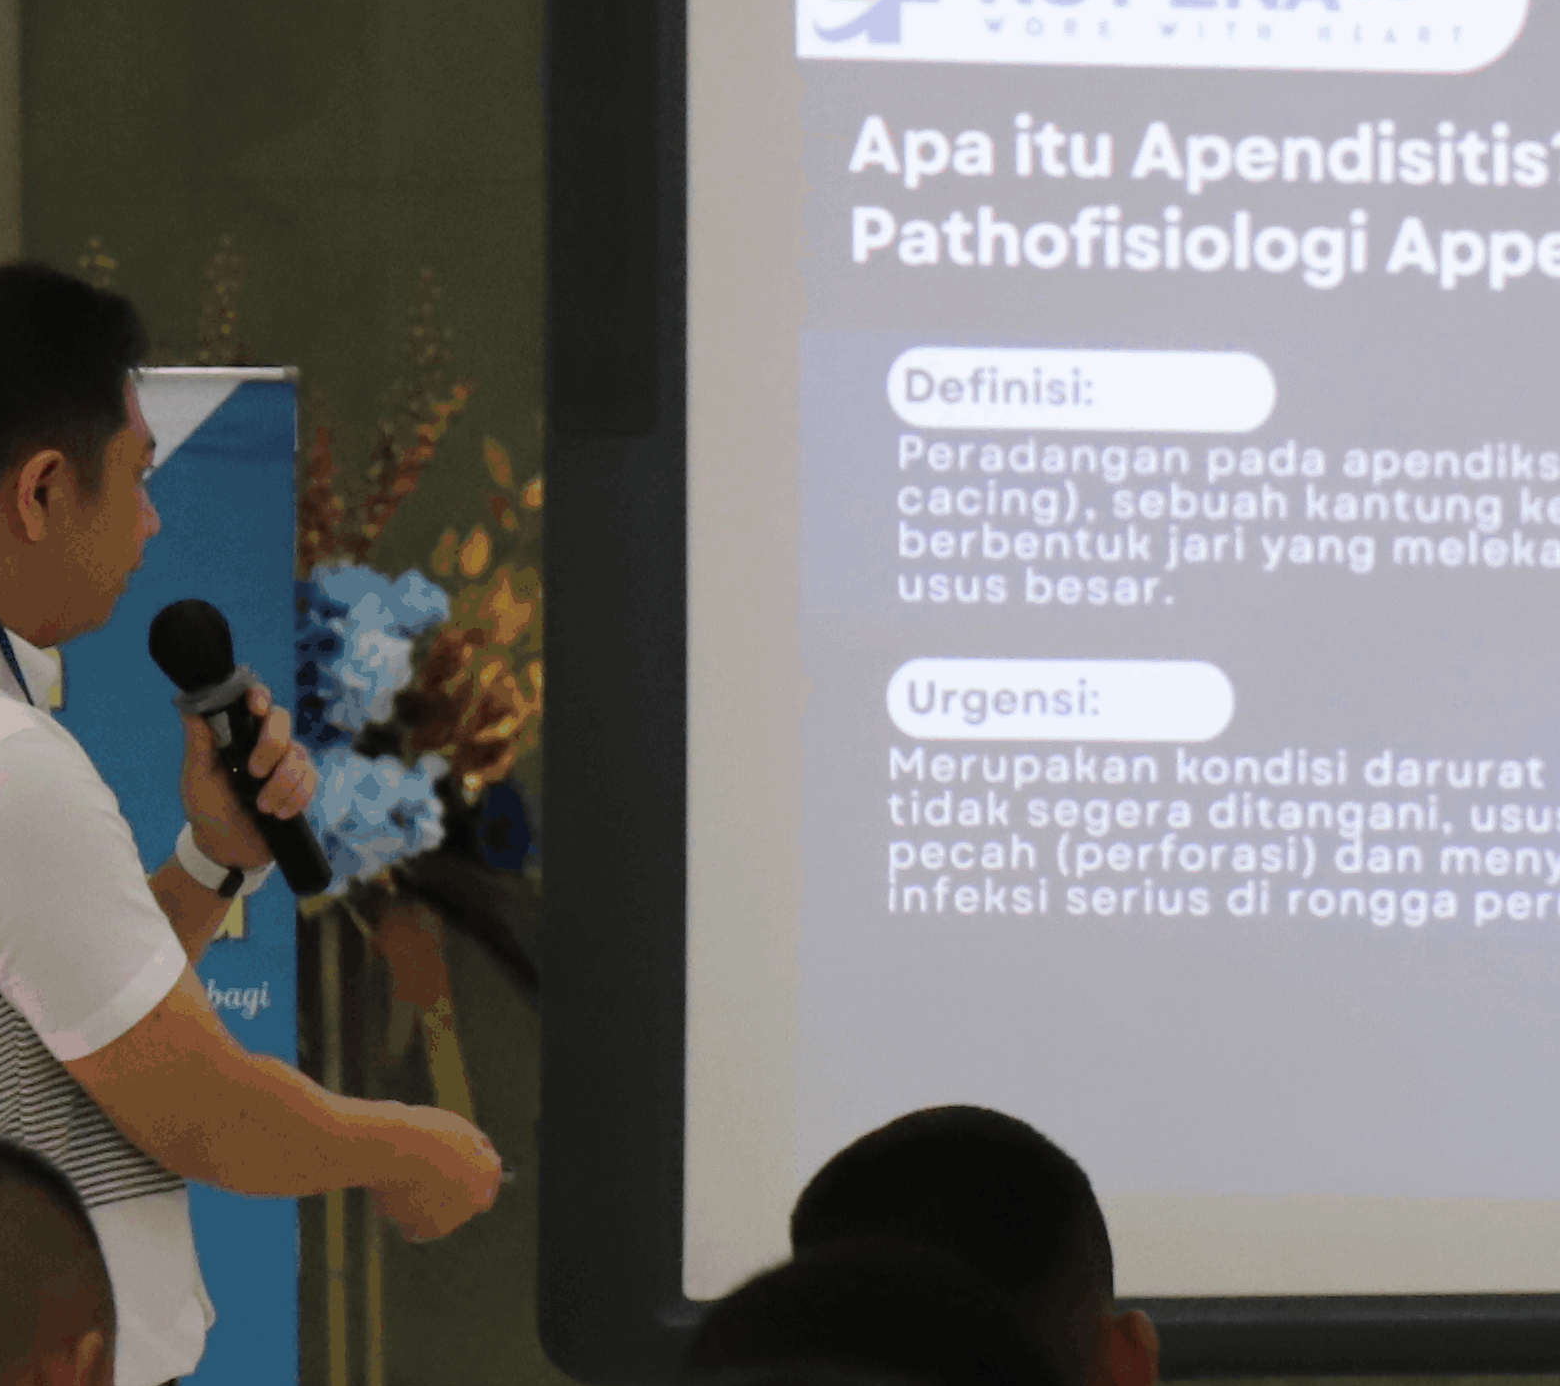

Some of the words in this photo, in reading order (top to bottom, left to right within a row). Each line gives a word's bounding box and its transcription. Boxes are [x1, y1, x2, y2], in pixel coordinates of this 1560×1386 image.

[849, 117, 994, 189] Apa
[1015, 116, 1112, 179] itu
[851, 206, 1367, 289] Pathofisiologi
[903, 366, 1096, 406] Definisi:
[899, 435, 1190, 481] Peradangan
[1207, 440, 1326, 484] pada
[898, 480, 1096, 524] cacing),
[1111, 483, 1288, 520] sebuah
[1305, 485, 1502, 531] kantung
[898, 525, 1152, 565] berbentuk
[1164, 527, 1244, 570] jari
[1261, 532, 1376, 572] yang
[898, 573, 1007, 604] usus
[1025, 568, 1175, 607] besar.
[906, 679, 1101, 728] Urgensi:
[889, 747, 1157, 791] Merupakan
[1176, 748, 1348, 787] kondisi
[1364, 750, 1545, 791] darurat
[888, 792, 1009, 829] tidak
[1027, 798, 1193, 838] segera
[1208, 792, 1453, 837] ditangani,
[887, 833, 1036, 879] pecah
[1055, 834, 1317, 879] (perforasi)
[1334, 838, 1423, 874] dan
[889, 877, 1048, 916] infeksi
[1066, 880, 1210, 917] serius
[1227, 880, 1271, 917] di
[1287, 886, 1456, 926] rongga
